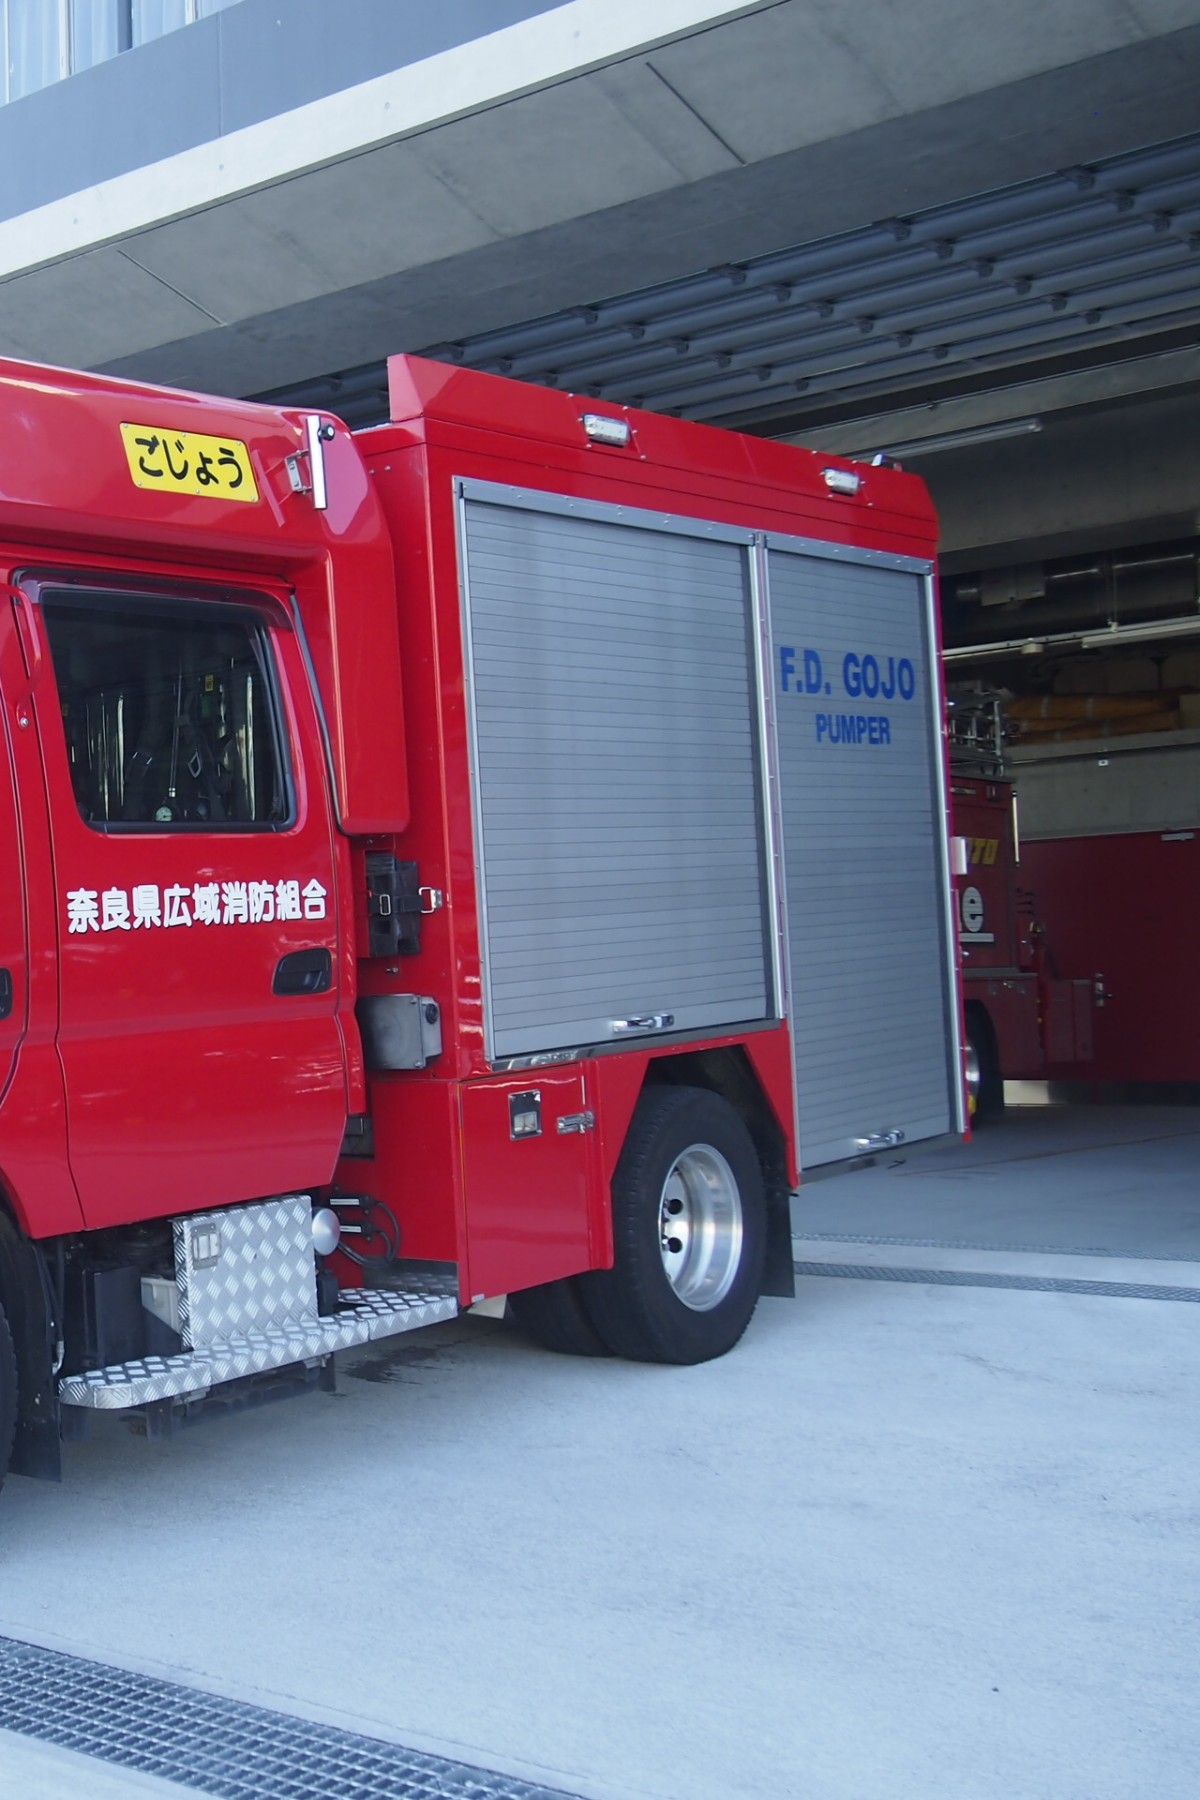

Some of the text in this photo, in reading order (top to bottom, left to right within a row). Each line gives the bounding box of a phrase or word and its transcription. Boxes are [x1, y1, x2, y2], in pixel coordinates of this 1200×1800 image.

[135, 435, 243, 488] ごじょう
[780, 646, 915, 701] F.D. GOJO
[816, 713, 891, 745] PUMPER
[67, 878, 327, 934] 奈良県広域消防組合
